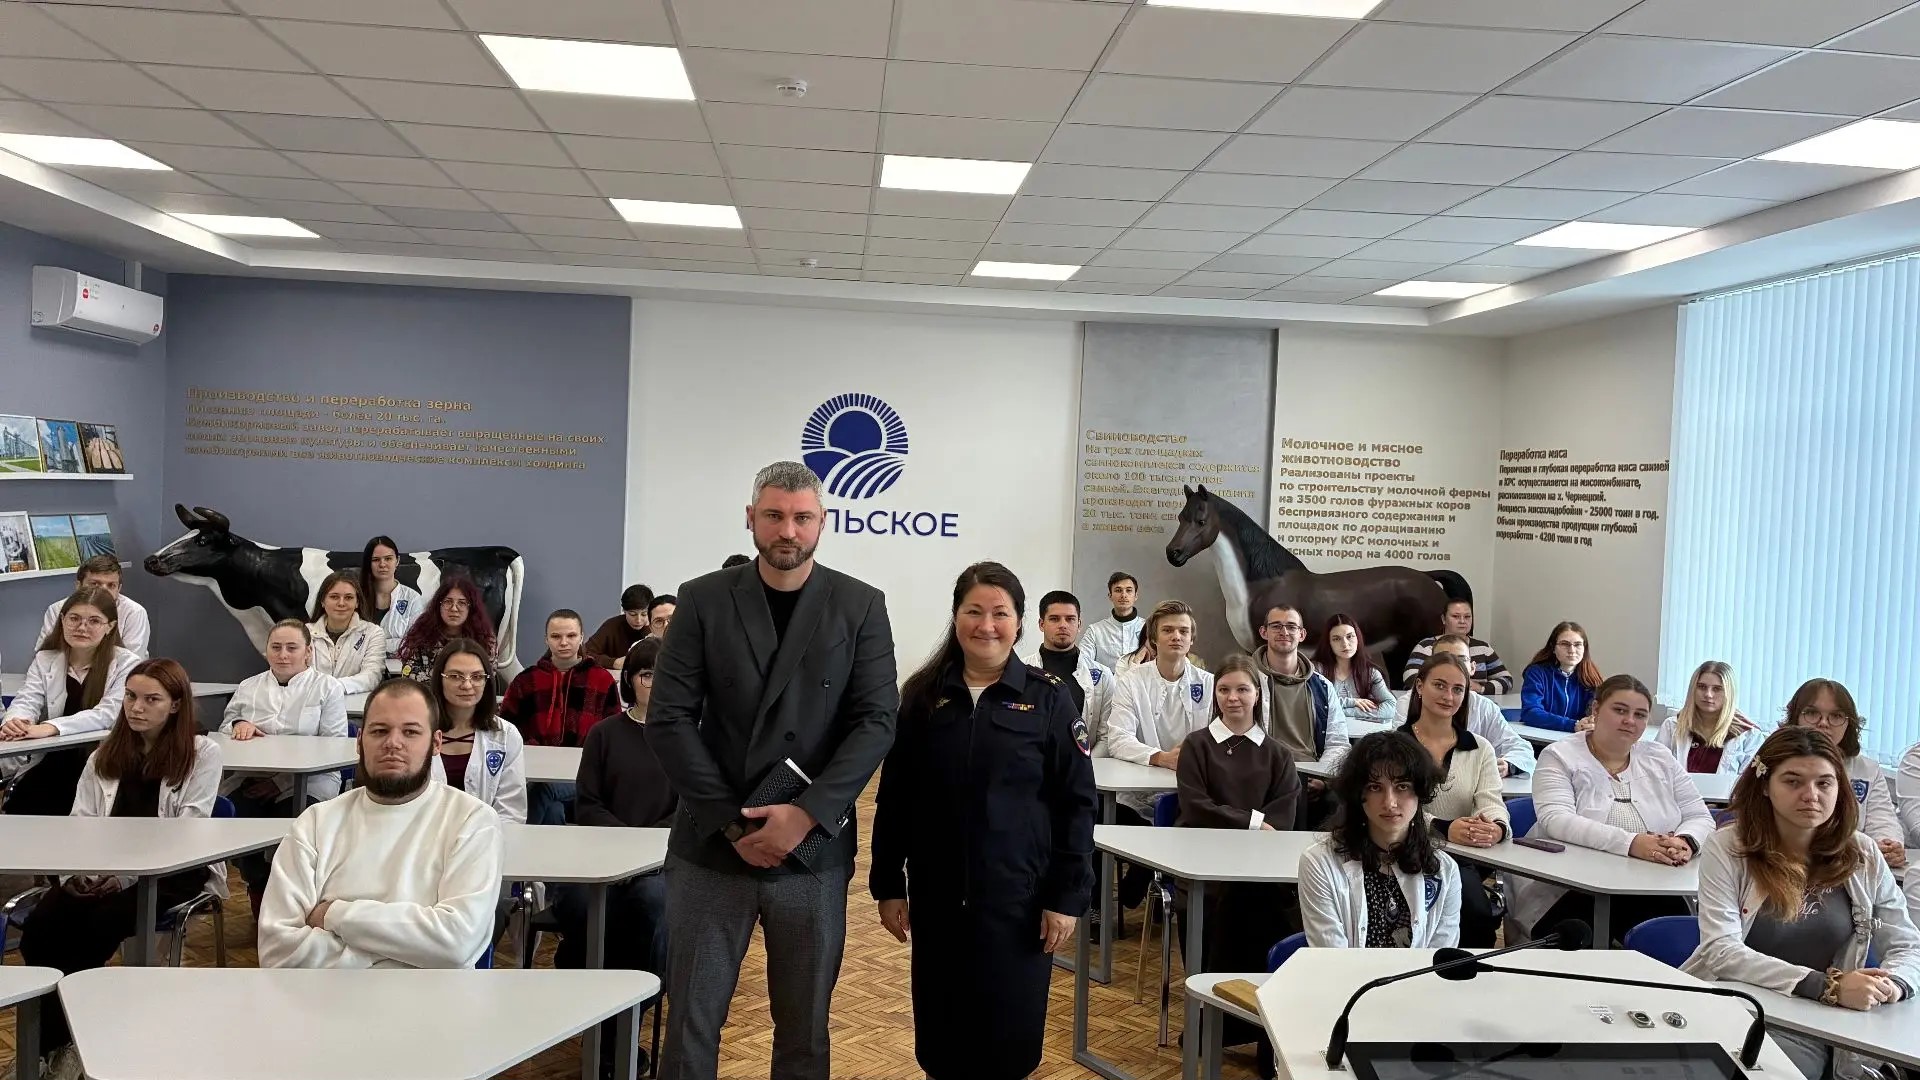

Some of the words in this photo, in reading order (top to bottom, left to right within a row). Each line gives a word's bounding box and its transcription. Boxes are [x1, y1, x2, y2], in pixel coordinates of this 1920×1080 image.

[187, 387, 300, 403] Производство
[305, 396, 315, 404] и
[320, 394, 421, 408] переработка
[426, 399, 472, 411] зерна
[332, 410, 372, 420] более
[376, 411, 392, 421] 20
[303, 424, 340, 434] завод
[344, 425, 454, 437] перерабатывает
[458, 430, 544, 441] выращенные
[548, 433, 563, 442] на
[568, 434, 606, 443] своих
[1086, 430, 1187, 444] Свиноводство
[368, 439, 376, 447] и
[380, 439, 469, 451] обеспечивает
[474, 444, 576, 455] качественными
[1085, 444, 1100, 454] На
[1104, 446, 1132, 456] трех
[1135, 448, 1203, 458] площадках
[1281, 438, 1354, 452] Молочное
[1358, 442, 1367, 451] и
[1372, 443, 1423, 454] мясное
[319, 452, 444, 464] животноводческие
[449, 456, 521, 466] комплексы
[526, 460, 586, 470] холдинга
[1281, 455, 1401, 468] животноводство
[1500, 448, 1547, 462] Переработка
[1549, 449, 1567, 459] мяса
[1085, 459, 1185, 470] свинокомплекса
[1499, 464, 1532, 474] Первичная
[1538, 463, 1569, 475] глубокая
[1570, 462, 1616, 474] переработка
[1618, 462, 1637, 472] мяса
[1639, 459, 1670, 471] свиней
[1084, 472, 1120, 481] около
[1124, 472, 1145, 481] 100
[1189, 476, 1223, 484] голов
[1280, 467, 1360, 480] Реализованы
[1364, 472, 1415, 483] проекты
[1084, 484, 1130, 494] свиней.
[1133, 485, 1185, 496] Ежегодн
[1504, 478, 1516, 486] КРС
[1518, 478, 1569, 488] осуществляется
[1570, 479, 1578, 487] на
[1580, 477, 1641, 489] мясокомбинате,
[1279, 482, 1295, 491] по
[1297, 483, 1383, 495] строительству
[1387, 486, 1446, 497] молочной
[1449, 488, 1491, 499] фермы
[1497, 491, 1547, 501] расположенном
[1548, 492, 1556, 501] на
[1557, 493, 1563, 501] х.
[1082, 498, 1153, 508] производит
[1279, 495, 1293, 504] на
[1296, 494, 1327, 505] 3500
[1330, 497, 1364, 507] голов
[1368, 497, 1432, 509] фуражных
[1436, 501, 1471, 511] коров
[1082, 509, 1096, 518] 20
[1278, 507, 1368, 520] беспривязного
[1371, 511, 1445, 523] содержания
[1449, 515, 1456, 523] и
[1497, 504, 1527, 514] Мощность
[1589, 506, 1613, 517] 25000
[1614, 509, 1633, 518] тонн
[1635, 510, 1640, 518] в
[1642, 510, 1659, 520] год.
[827, 509, 958, 537] ЛЬСКОЕ
[1093, 524, 1132, 533] живом
[1136, 525, 1165, 534] весе
[1278, 521, 1339, 532] площадок
[1343, 523, 1357, 532] по
[1360, 525, 1446, 536] доращиванию
[1517, 518, 1560, 529] производства
[1561, 521, 1599, 532] продукции
[1600, 521, 1638, 534] глубокой
[1277, 534, 1285, 542] и
[1287, 534, 1338, 546] откорму
[1341, 535, 1365, 545] КРС
[1368, 538, 1428, 548] молочных
[1432, 540, 1440, 548] и
[1496, 529, 1534, 540] переработки
[1539, 532, 1556, 542] 4200
[1556, 535, 1573, 544] тонн
[1579, 536, 1592, 546] год
[1288, 548, 1323, 557] сных
[1326, 549, 1362, 560] пород
[1366, 550, 1381, 559] на
[1384, 549, 1414, 560] 4000
[1417, 551, 1451, 561] голов
